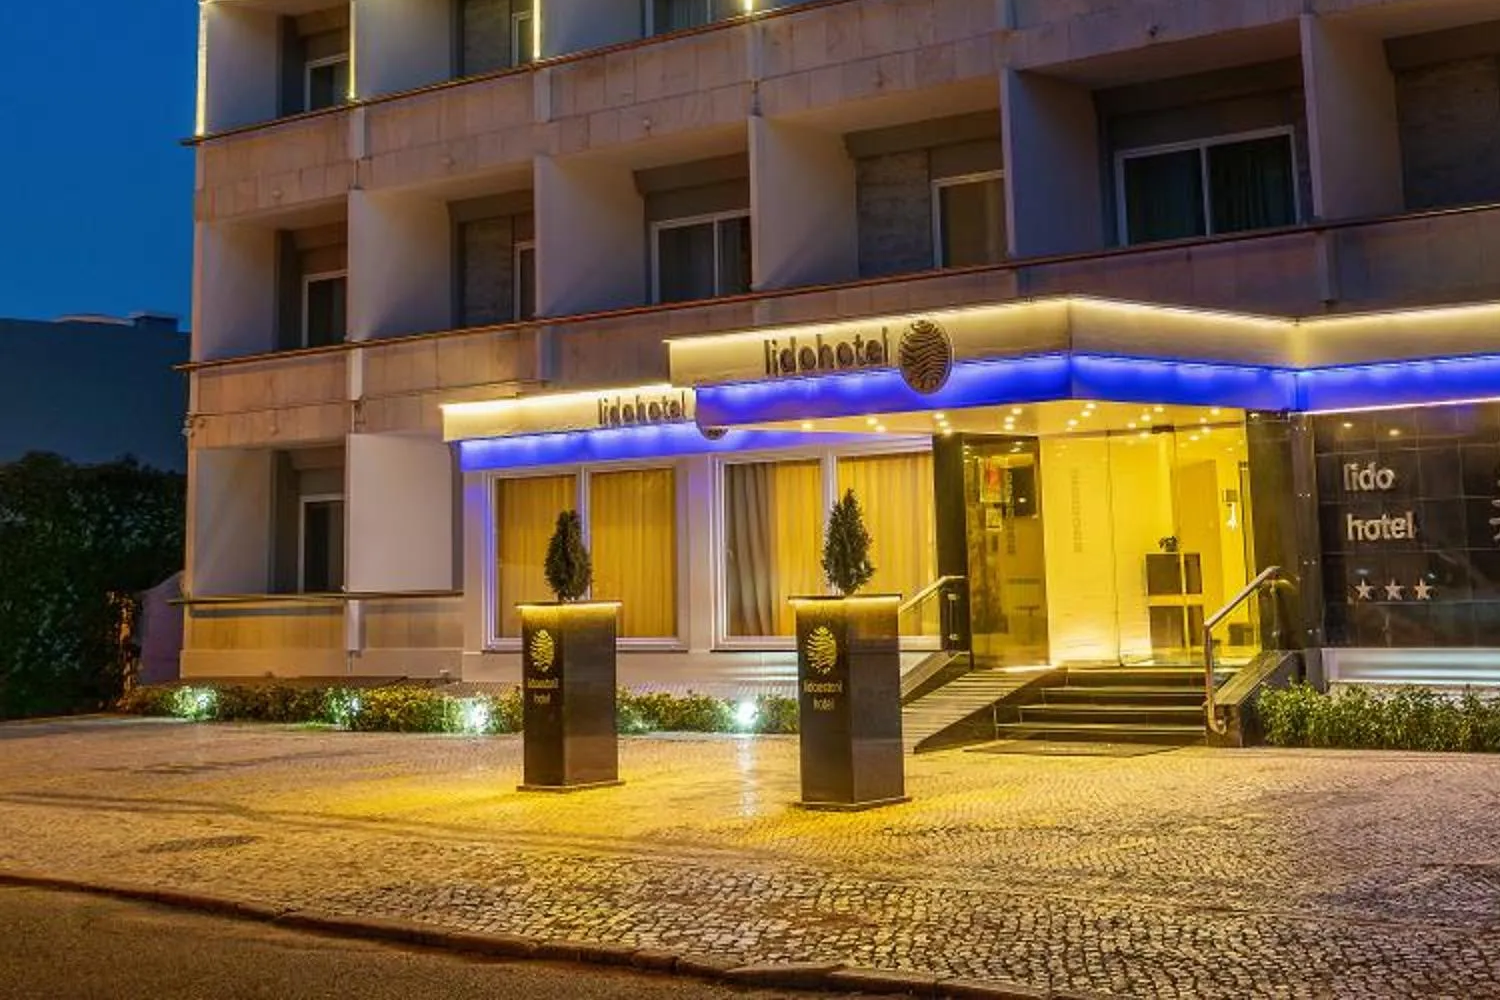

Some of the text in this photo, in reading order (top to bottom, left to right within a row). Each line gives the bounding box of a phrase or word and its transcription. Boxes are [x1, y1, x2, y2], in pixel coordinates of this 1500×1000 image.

[763, 326, 889, 377] lidohotel
[597, 391, 685, 426] lidohotel
[1343, 461, 1396, 491] lido
[1345, 510, 1415, 541] hotel
